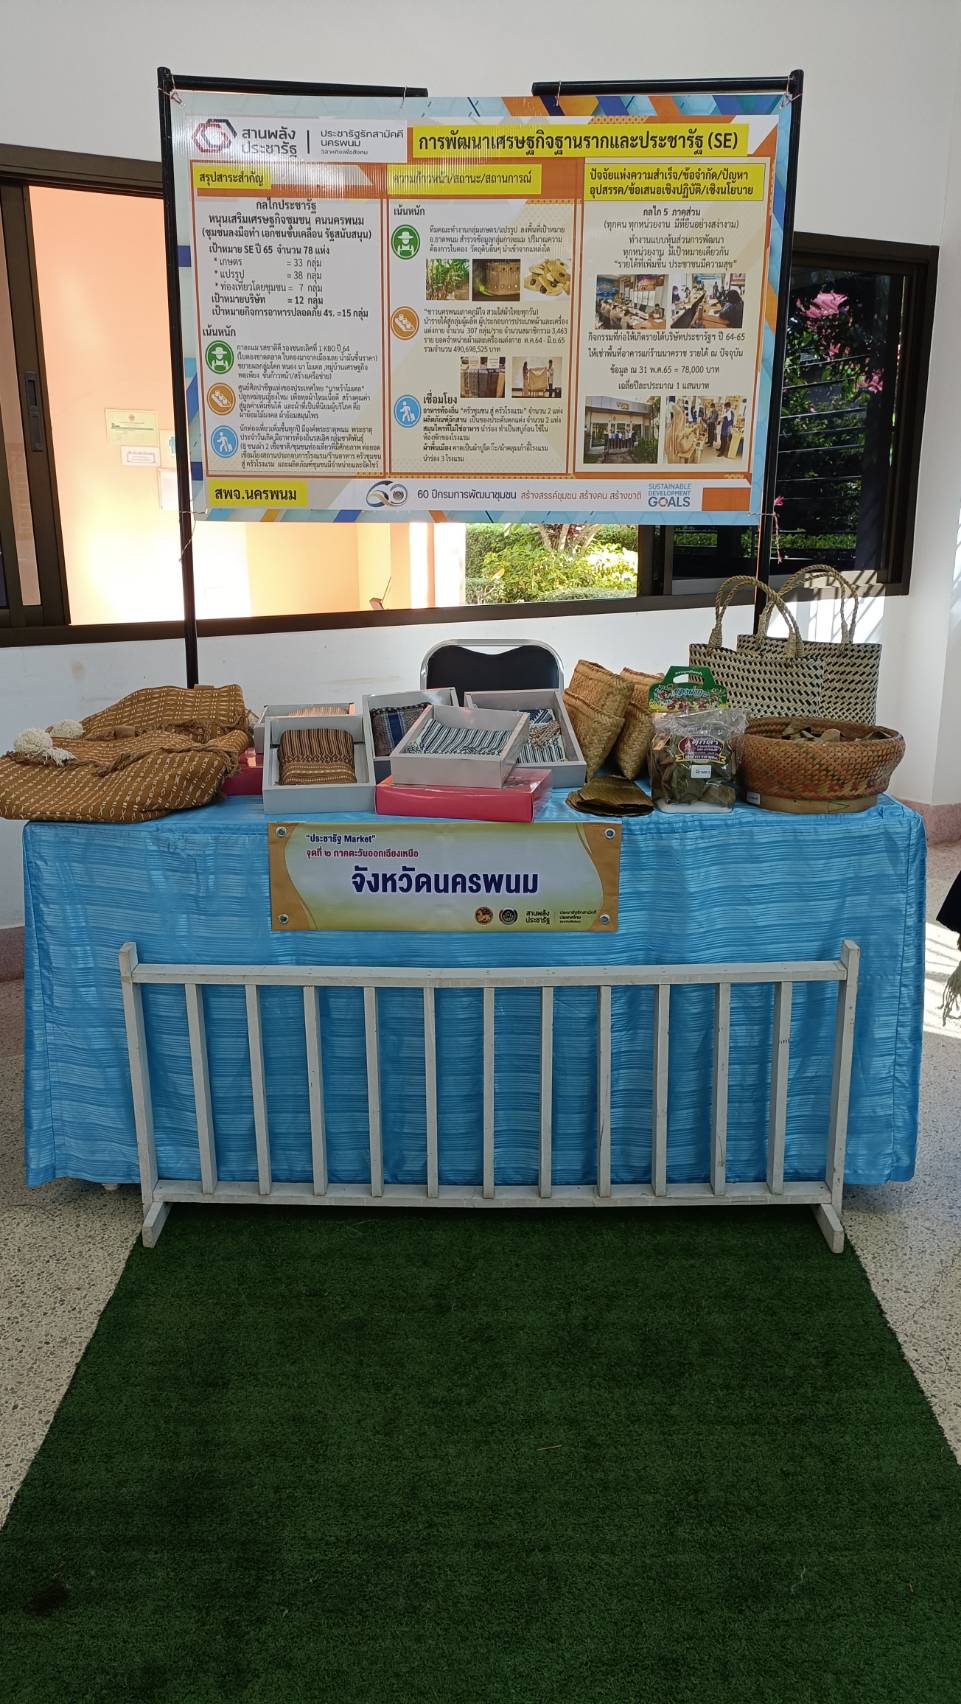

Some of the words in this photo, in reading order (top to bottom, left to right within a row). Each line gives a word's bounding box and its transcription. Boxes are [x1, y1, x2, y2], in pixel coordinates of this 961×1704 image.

[242, 126, 295, 140] สานพลัง
[242, 142, 297, 158] ประชารัฐ
[321, 139, 361, 147] นครพนม
[419, 130, 704, 156] การพัฒนาเศรษฐกิจฐานรากและประชารัฐ
[707, 131, 738, 151] (SE)
[590, 166, 748, 182] ปัจจัยแห่งความสำเร็จ/ข้อจำกัด/ปัญหา
[590, 182, 753, 198] อุปสรรค/ข้อเสนอเชิงปฏิบัติ/เชิงนโยบาย
[256, 197, 317, 214] กลไกประชารัฐ
[393, 205, 425, 216] เน้นหนัก
[643, 206, 661, 216] กลไก
[209, 213, 311, 228] หนุนเสริมเศรษฐกิจชุมชน
[315, 217, 364, 226] คนนครพนม
[325, 229, 372, 242] รัฐสนับสนุน)
[209, 244, 242, 254] เป้าหมาย
[244, 245, 254, 254] SE
[256, 244, 262, 254] ปี
[263, 246, 273, 254] 65
[277, 246, 302, 254] จำนวน
[304, 246, 313, 254] 78
[315, 246, 330, 255] แห่ง
[220, 258, 242, 267] เกษตร
[294, 259, 303, 267] 33
[306, 257, 322, 271] กลุ่ม
[220, 270, 245, 282] แปรรูป
[294, 271, 303, 279] 38
[306, 270, 322, 284] กลุ่ม
[299, 284, 304, 292] 7
[308, 283, 323, 297] กลุ่ม
[211, 293, 266, 304] เป้าหมายบริษัท
[308, 295, 324, 309] กลุ่ม
[353, 307, 369, 320] กลุ่ม
[202, 325, 236, 336] เน้นหนัก
[718, 331, 723, 341] ปี
[726, 333, 745, 341] 64-65
[611, 365, 628, 376] ข้อมูล
[681, 366, 704, 374] 78,000
[424, 390, 457, 404] เชื่อมโยง
[215, 488, 297, 500] สพจ.นครพนม
[418, 490, 429, 499] 60
[432, 488, 517, 502] ปีกรมการพัฒนาชุมชน
[648, 497, 691, 508] GOALS
[307, 849, 322, 859] จุดที่
[334, 849, 418, 859] ภาคตะวันออกเฉียงเหนือ
[352, 865, 538, 894] จังหวัดนครพนม
